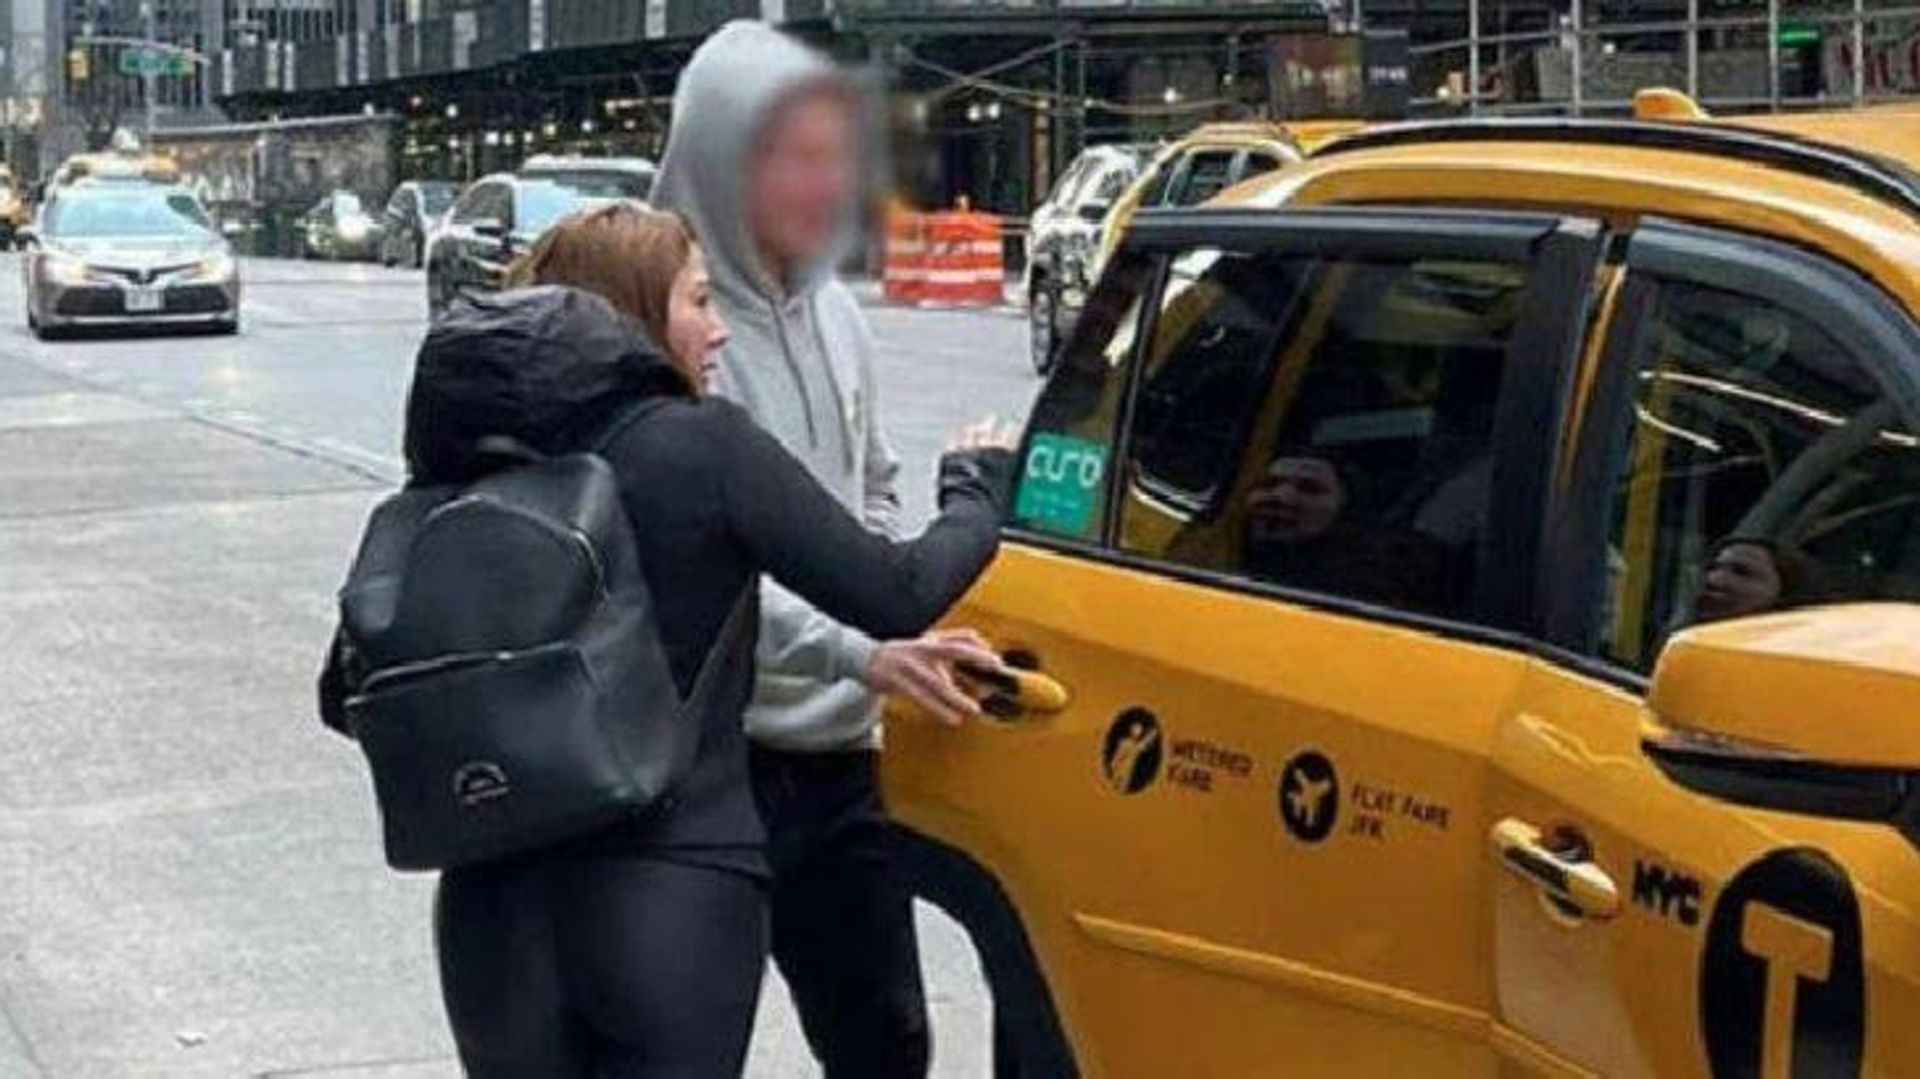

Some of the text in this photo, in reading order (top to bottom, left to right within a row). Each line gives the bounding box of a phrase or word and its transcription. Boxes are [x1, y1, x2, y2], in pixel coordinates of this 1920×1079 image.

[1167, 765, 1213, 793] FARE
[1350, 813, 1383, 839] JFK
[1352, 783, 1450, 831] FLAT FARE
[1634, 860, 1701, 925] NYC
[1742, 900, 1833, 1079] T
